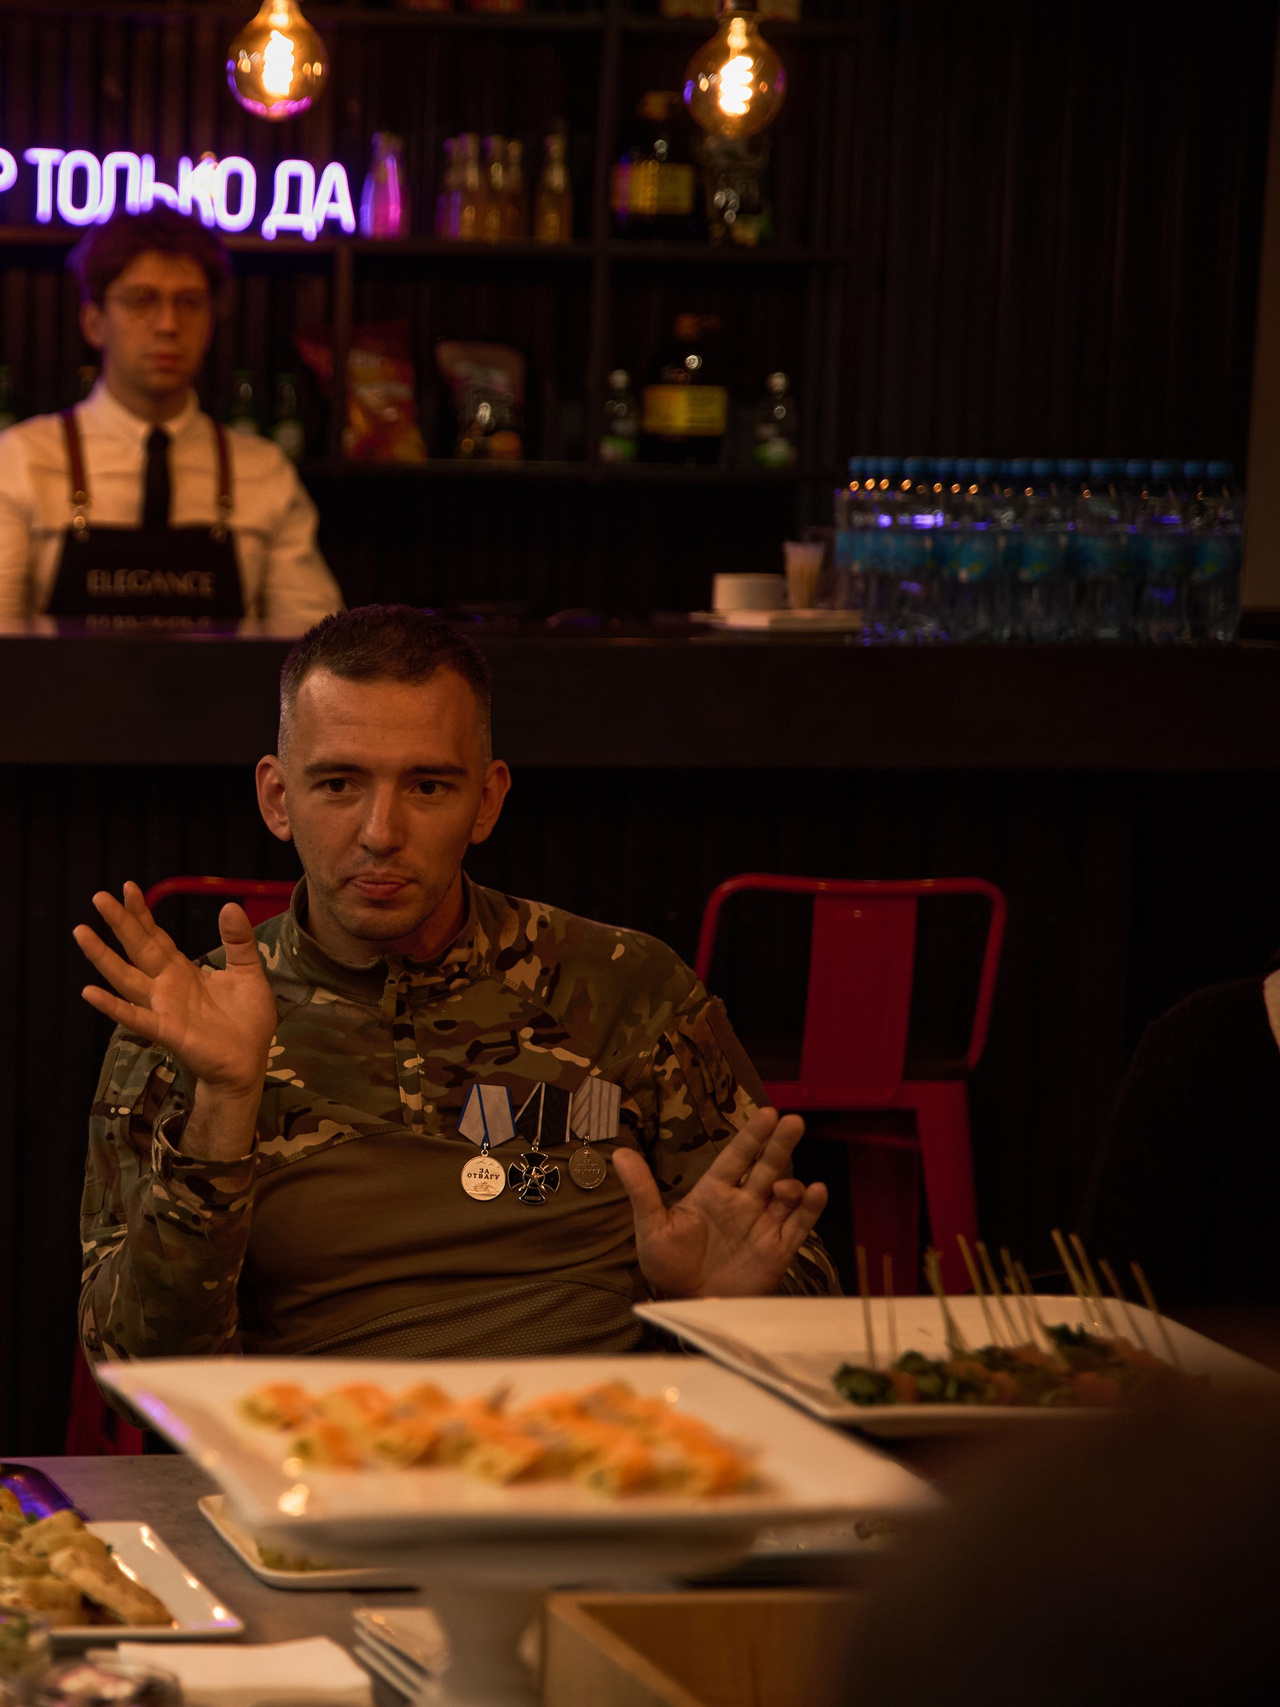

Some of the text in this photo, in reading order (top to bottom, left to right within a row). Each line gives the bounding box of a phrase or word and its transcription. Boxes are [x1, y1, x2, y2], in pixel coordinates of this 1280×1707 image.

[23, 146, 257, 233] ТОЛЬКО
[260, 158, 357, 242] ДА
[86, 568, 217, 599] ELEGANCE
[467, 1172, 501, 1180] ОТВАГУ
[478, 1167, 490, 1175] ЗА
